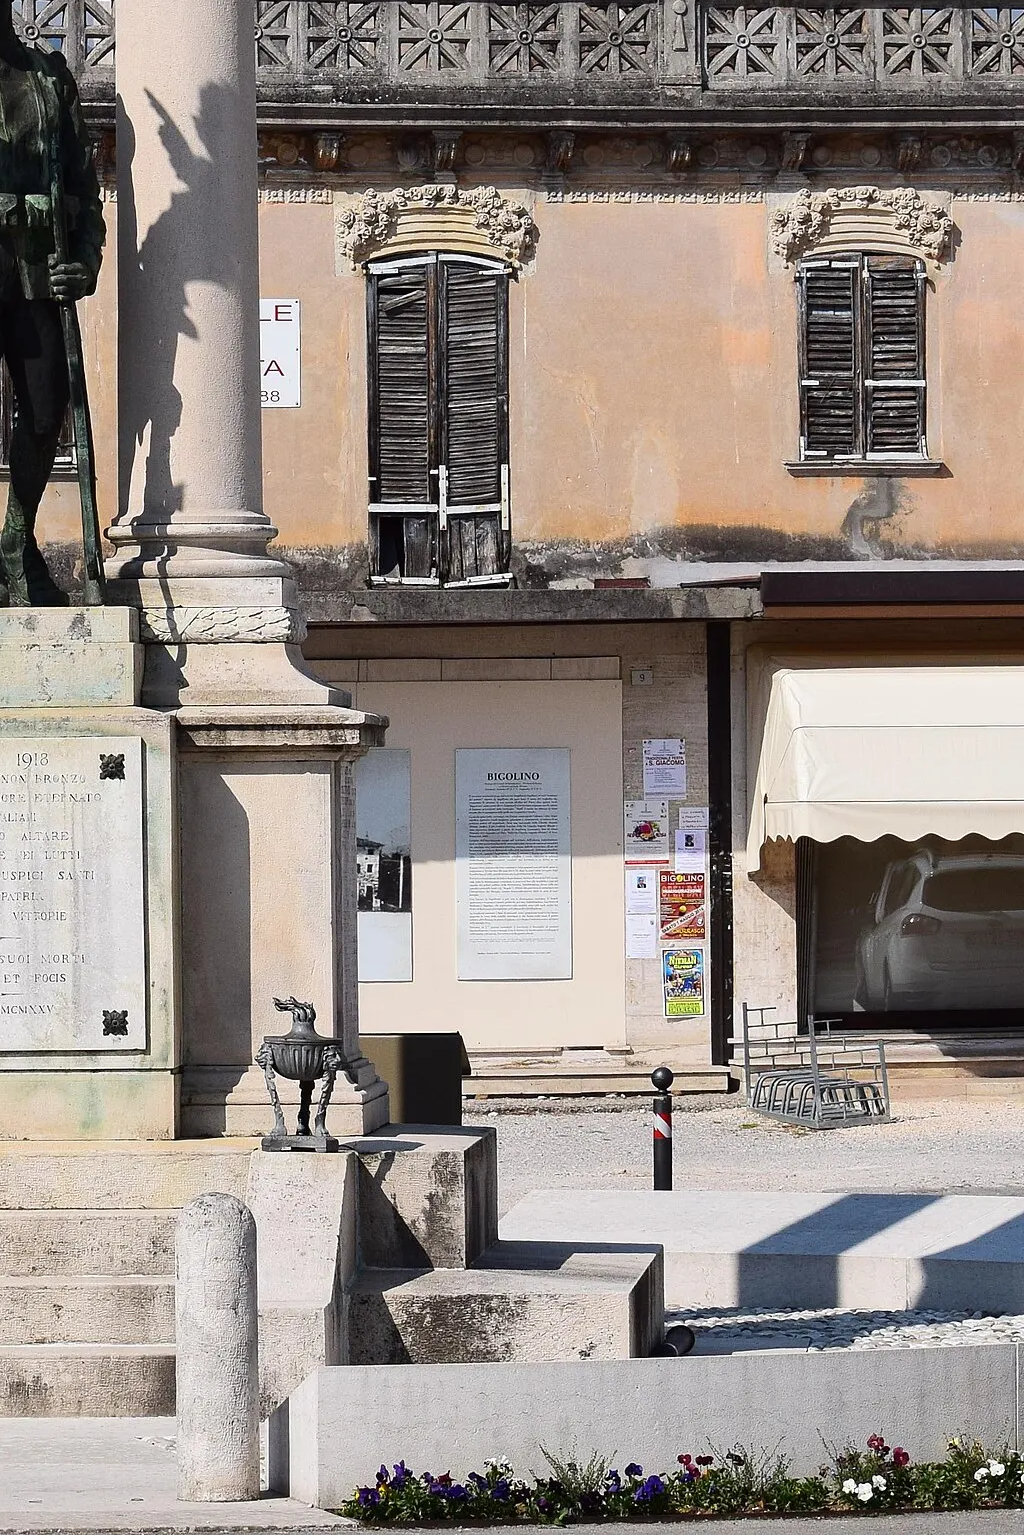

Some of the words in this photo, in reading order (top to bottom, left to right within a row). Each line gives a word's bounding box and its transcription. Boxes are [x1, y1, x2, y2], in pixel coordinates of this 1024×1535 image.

[640, 674, 644, 682] 9
[17, 753, 48, 770] 1918
[2, 774, 26, 784] NON
[35, 774, 86, 784] BRONZO
[487, 772, 540, 781] BIGOLINO
[22, 832, 69, 841] ALTARE
[41, 954, 85, 964] MORTI
[4, 974, 20, 983] ET
[34, 974, 66, 982] FOCIS
